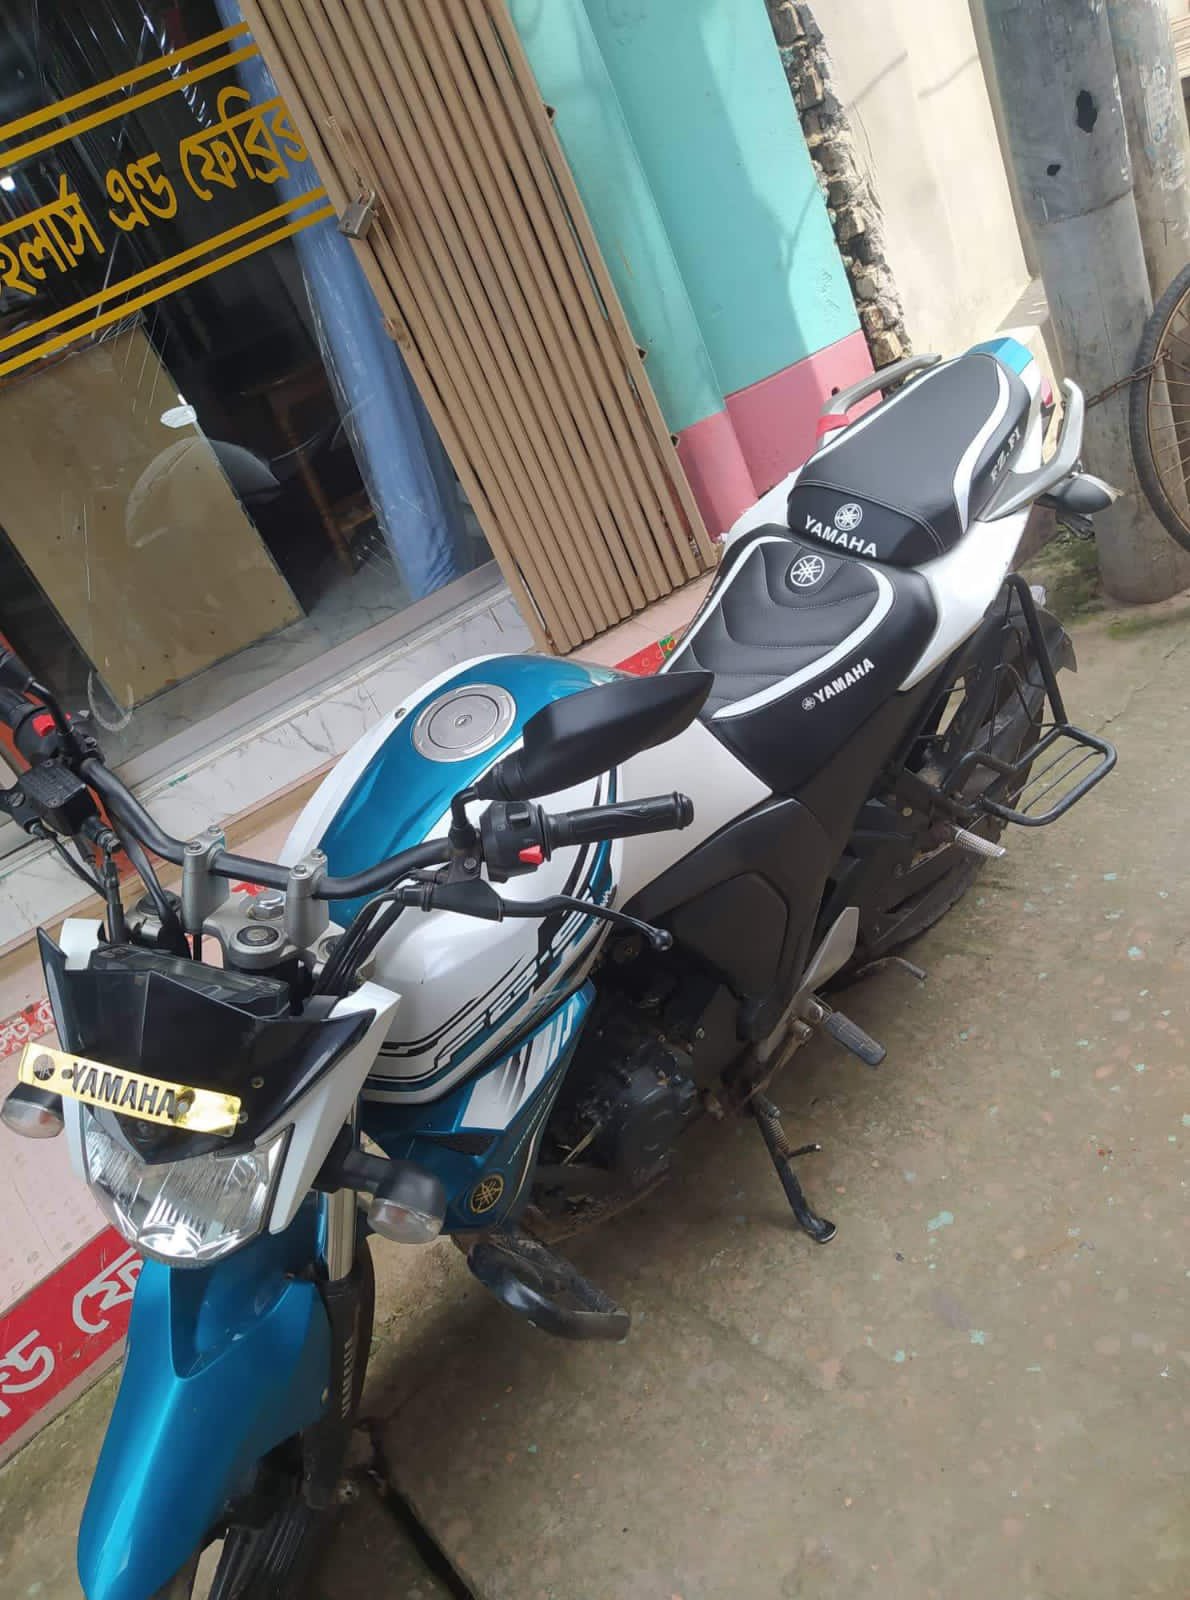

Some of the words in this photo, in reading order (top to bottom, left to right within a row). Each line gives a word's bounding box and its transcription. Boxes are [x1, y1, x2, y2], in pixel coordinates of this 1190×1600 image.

[804, 514, 877, 558] YAMAHA
[813, 658, 875, 703] YAMAHA
[71, 1062, 179, 1120] YAMAHA
